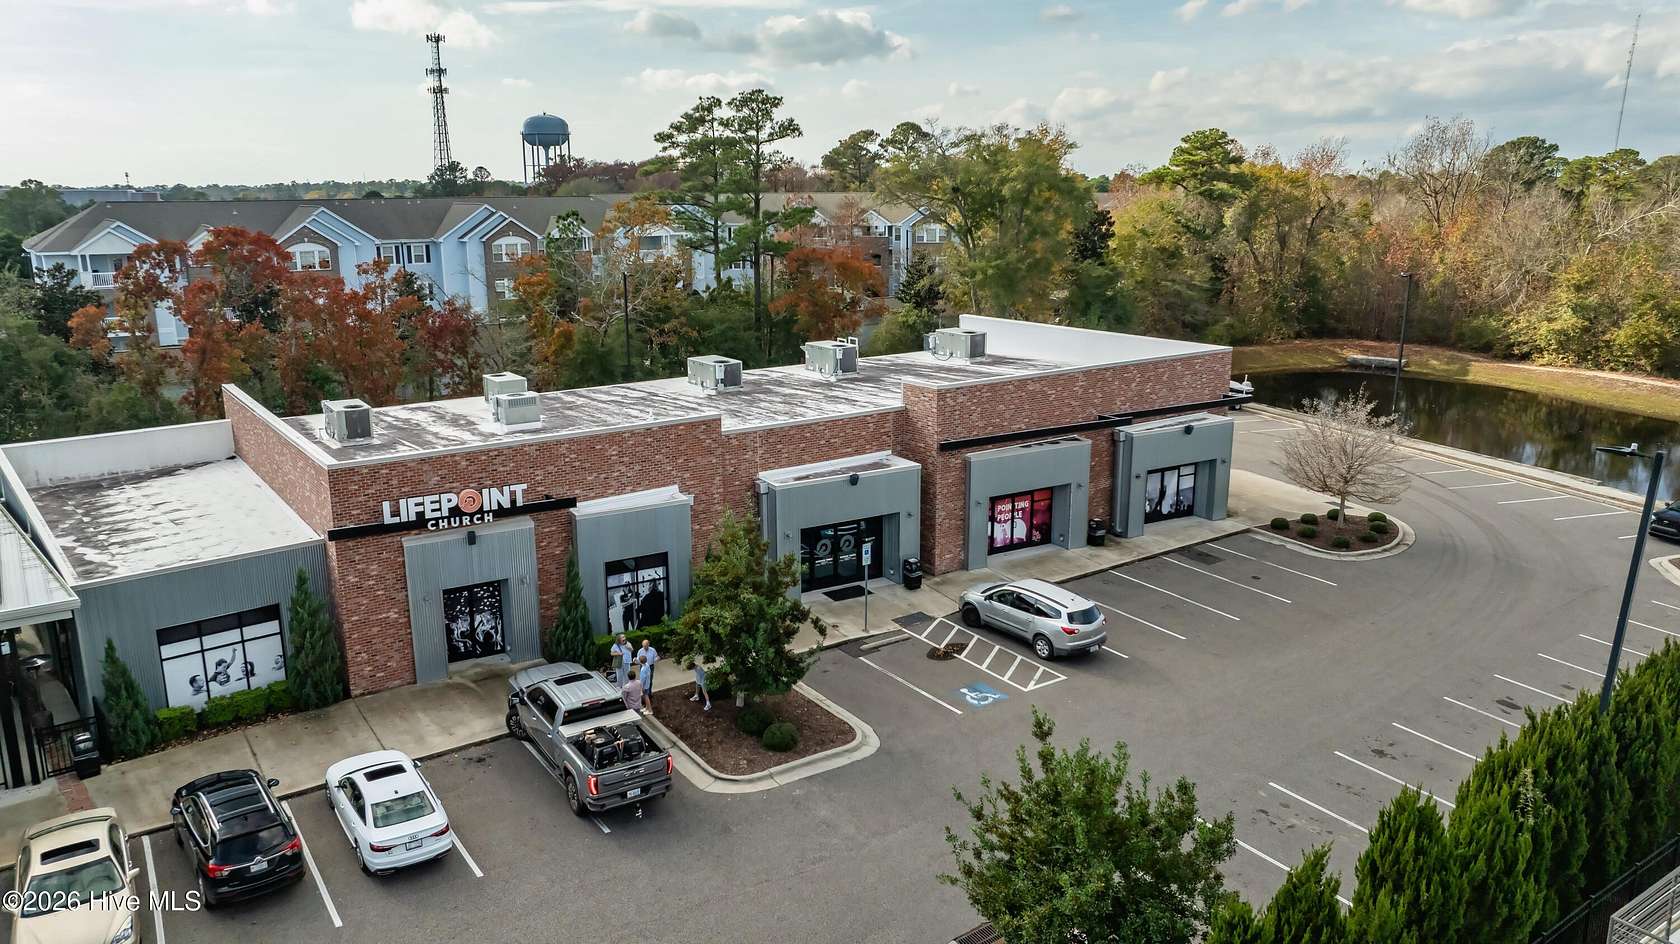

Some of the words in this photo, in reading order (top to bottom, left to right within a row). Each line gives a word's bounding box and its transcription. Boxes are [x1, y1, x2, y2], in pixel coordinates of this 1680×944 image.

[382, 484, 527, 525] LIFEPOINT
[997, 501, 1029, 512] POINTING
[427, 512, 494, 531] CHURCH
